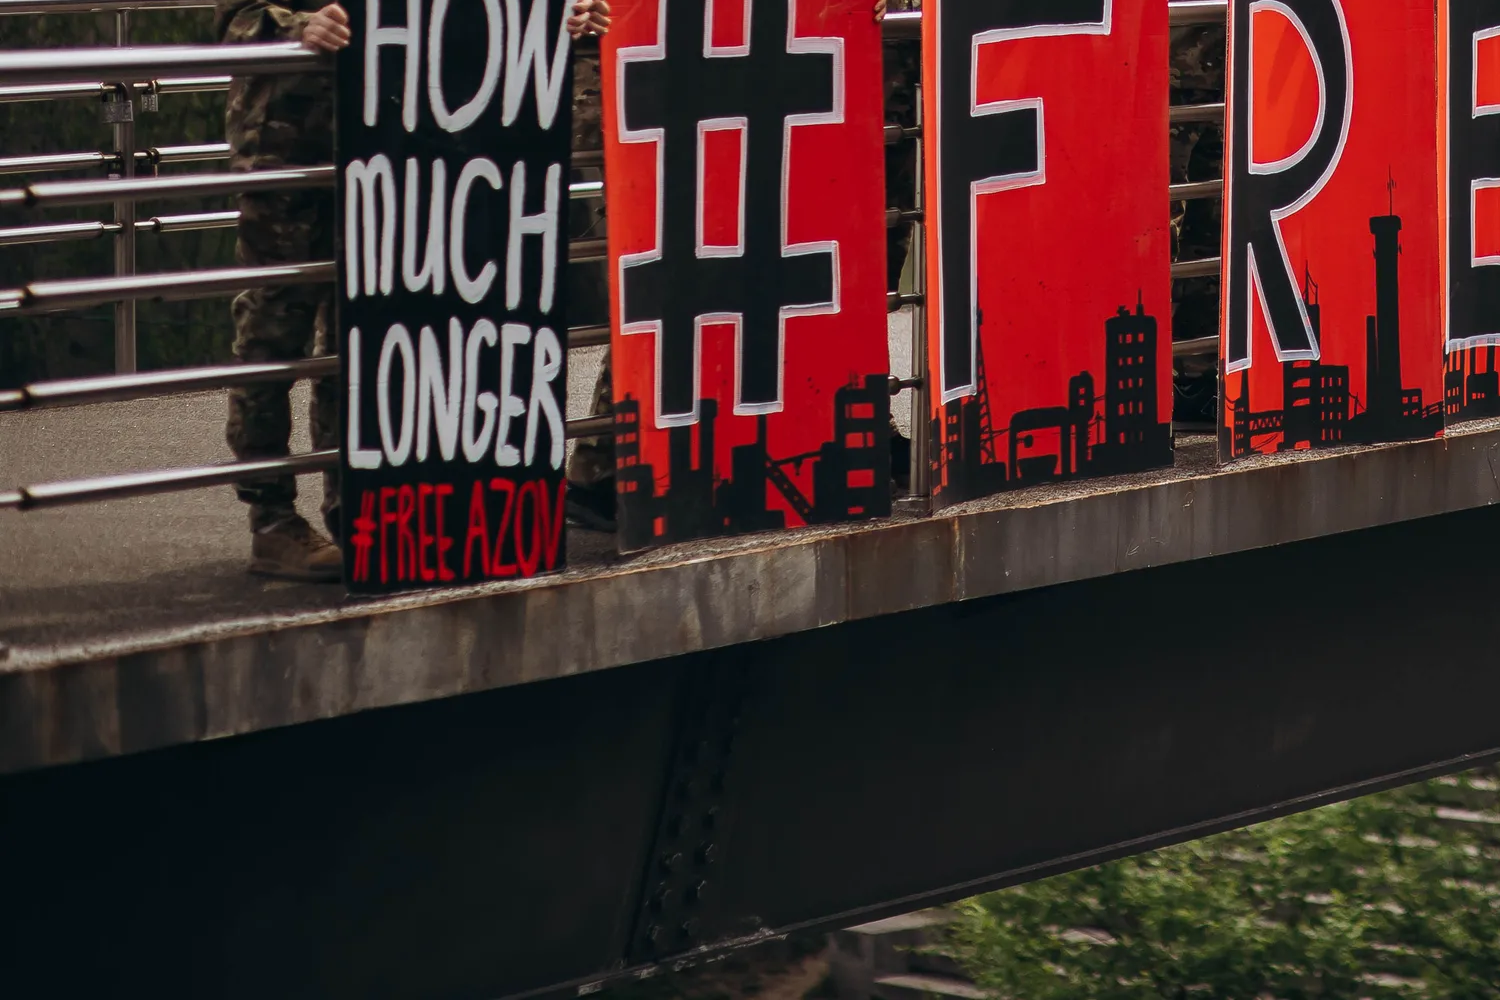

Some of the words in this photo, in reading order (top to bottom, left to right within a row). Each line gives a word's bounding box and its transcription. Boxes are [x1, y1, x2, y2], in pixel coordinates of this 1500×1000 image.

[345, 153, 562, 315] MUCH
[347, 319, 565, 470] LONGER
[350, 482, 456, 584] #FREE
[463, 477, 568, 578] AZOV
